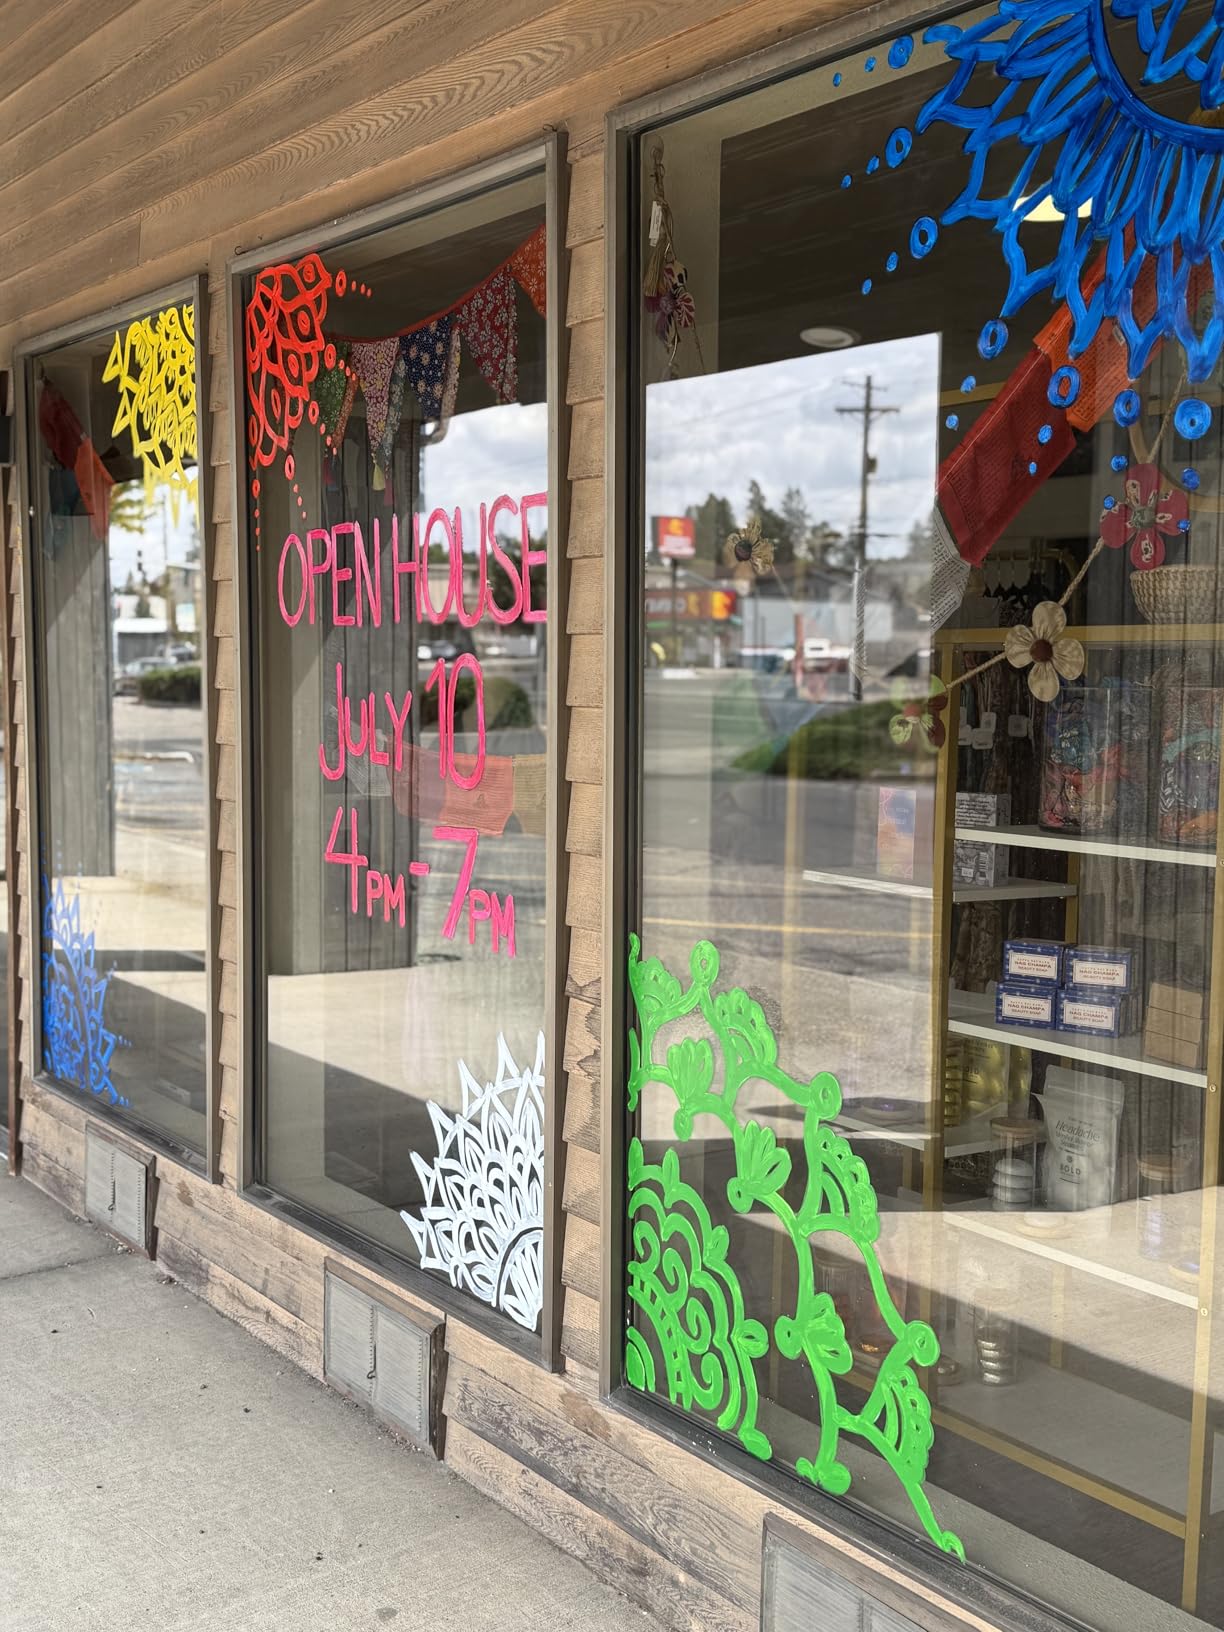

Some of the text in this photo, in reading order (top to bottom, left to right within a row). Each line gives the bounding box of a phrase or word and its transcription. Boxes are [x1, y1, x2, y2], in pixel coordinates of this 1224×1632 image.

[278, 493, 548, 627] OPEN HOUSE
[319, 652, 486, 790] JULY 10
